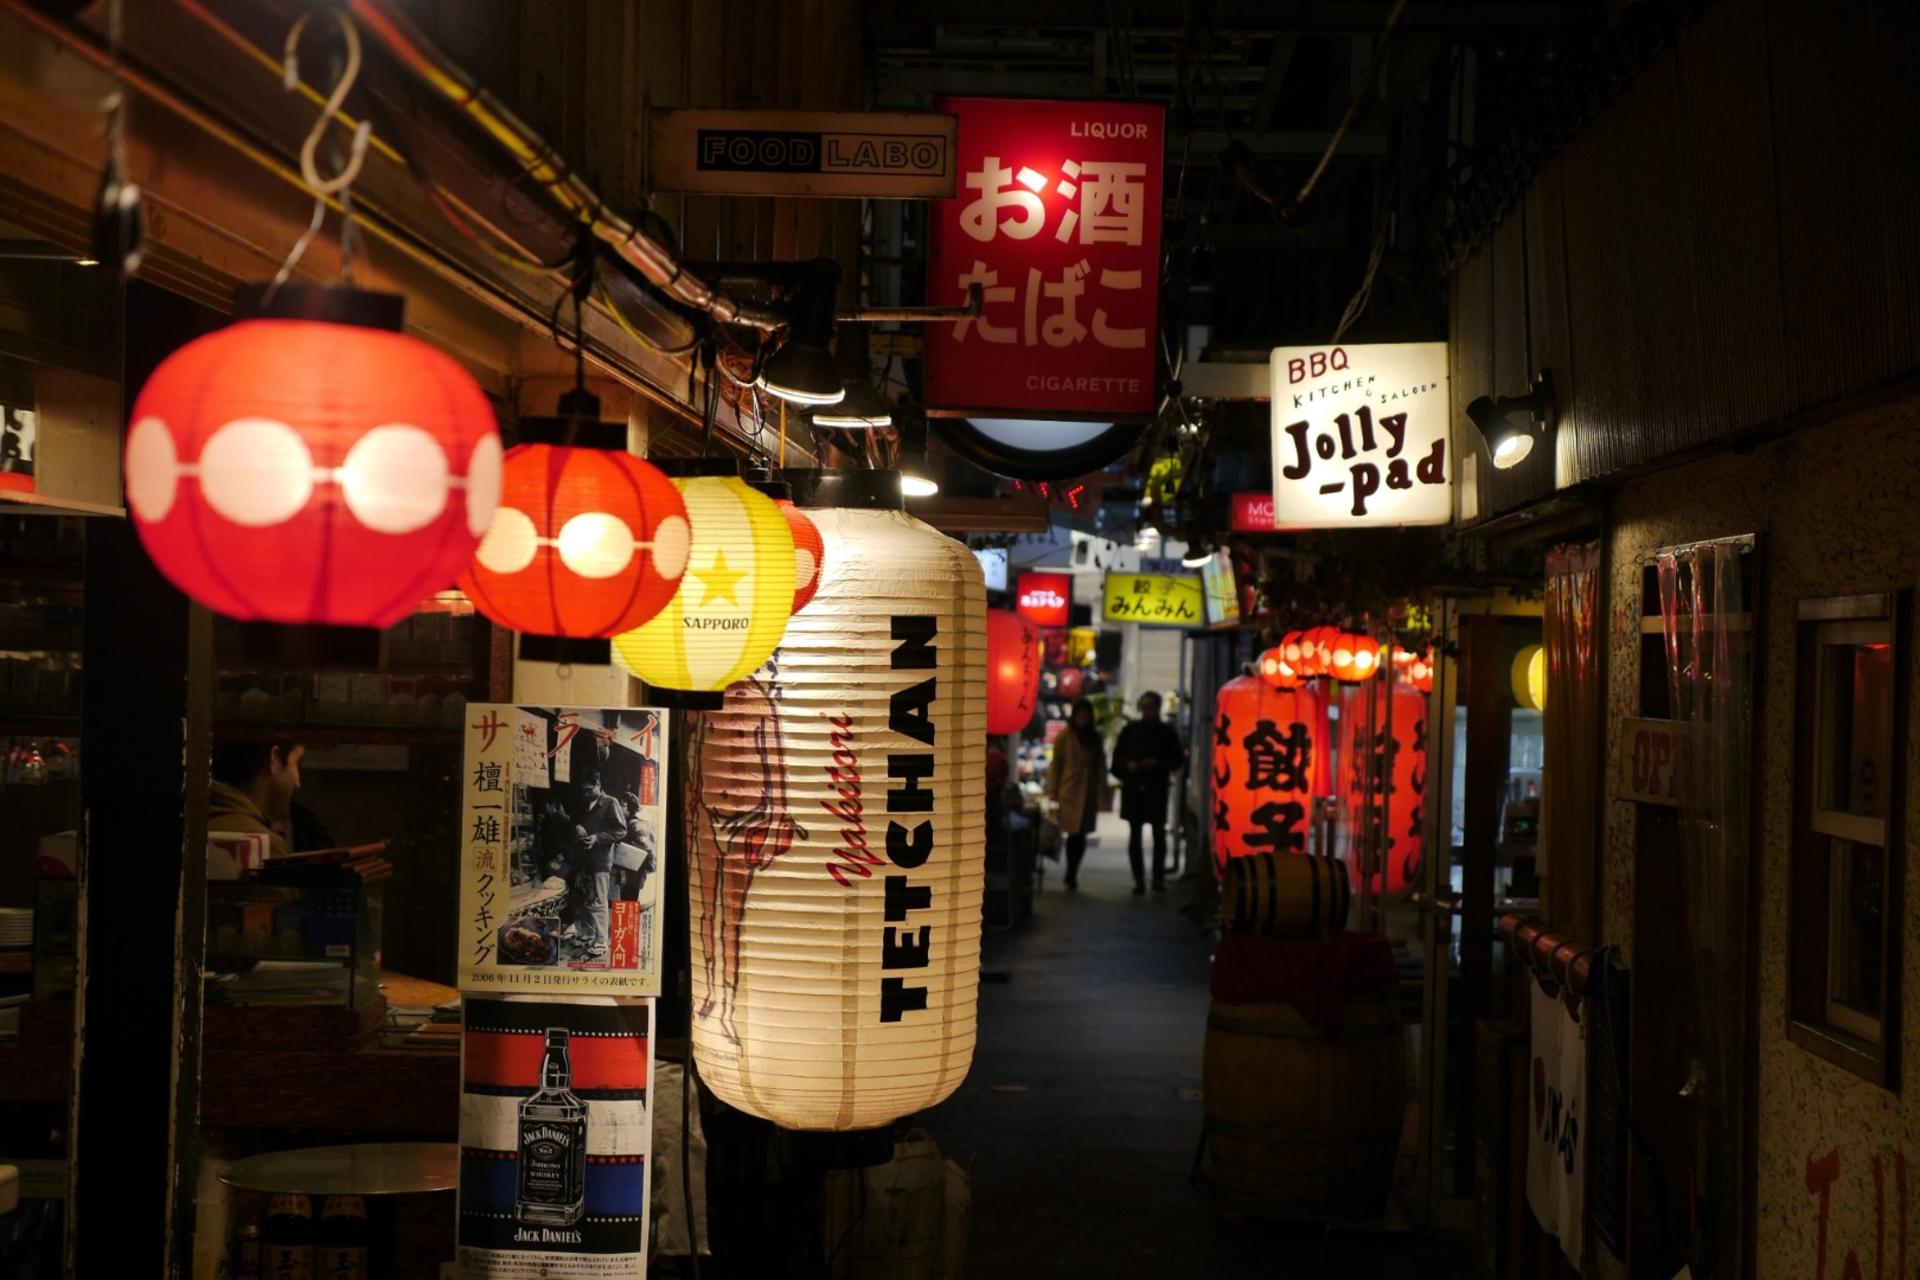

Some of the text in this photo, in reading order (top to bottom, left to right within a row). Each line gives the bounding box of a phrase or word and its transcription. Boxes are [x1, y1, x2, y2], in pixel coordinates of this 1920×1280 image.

[1071, 121, 1149, 140] LIQUOR
[704, 136, 942, 170] FOOD LABO
[959, 156, 1148, 247] お酒
[952, 259, 1147, 349] たばこ
[1288, 347, 1350, 385] BBQ
[1026, 375, 1141, 394] CIGARETTE
[1292, 375, 1376, 409] KITCHEN
[1380, 382, 1438, 404] SALOON
[1282, 404, 1408, 480] Jolly
[683, 616, 750, 631] SAPPORO
[1110, 595, 1196, 620] みんみん
[818, 710, 886, 889] Yakitori
[879, 614, 939, 1024] TETCHAN
[513, 1227, 583, 1244] JACK DANIEL'S
